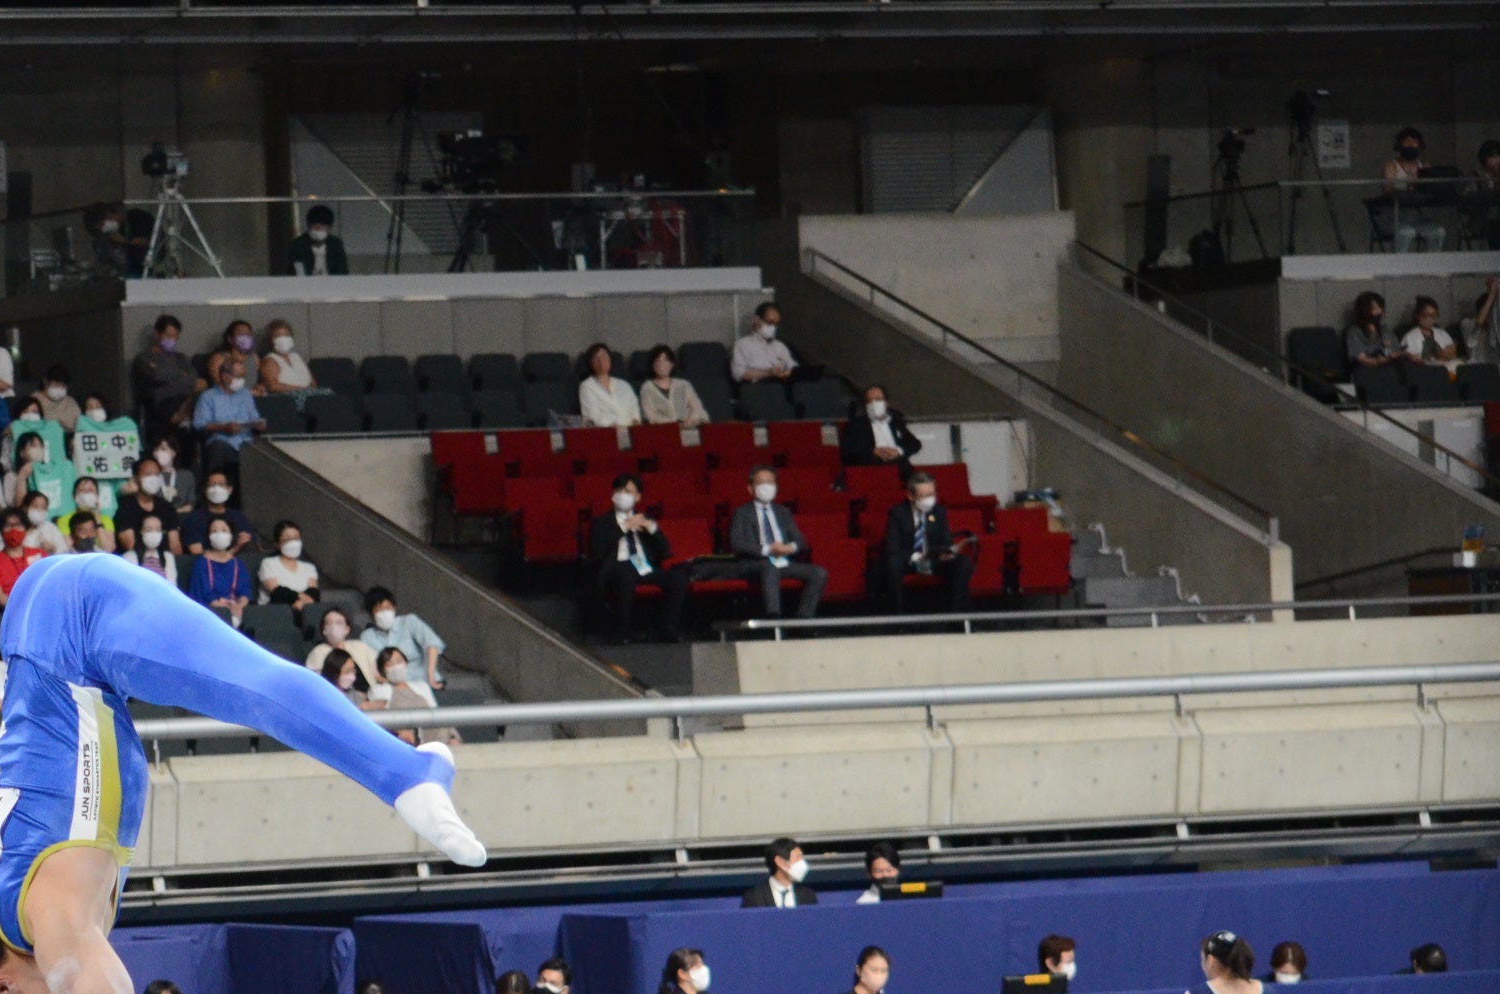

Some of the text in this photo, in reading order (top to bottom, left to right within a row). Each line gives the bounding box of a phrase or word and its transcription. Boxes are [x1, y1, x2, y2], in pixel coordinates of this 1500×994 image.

[82, 434, 127, 452] 田中
[81, 743, 91, 820] JUN SPORTS
